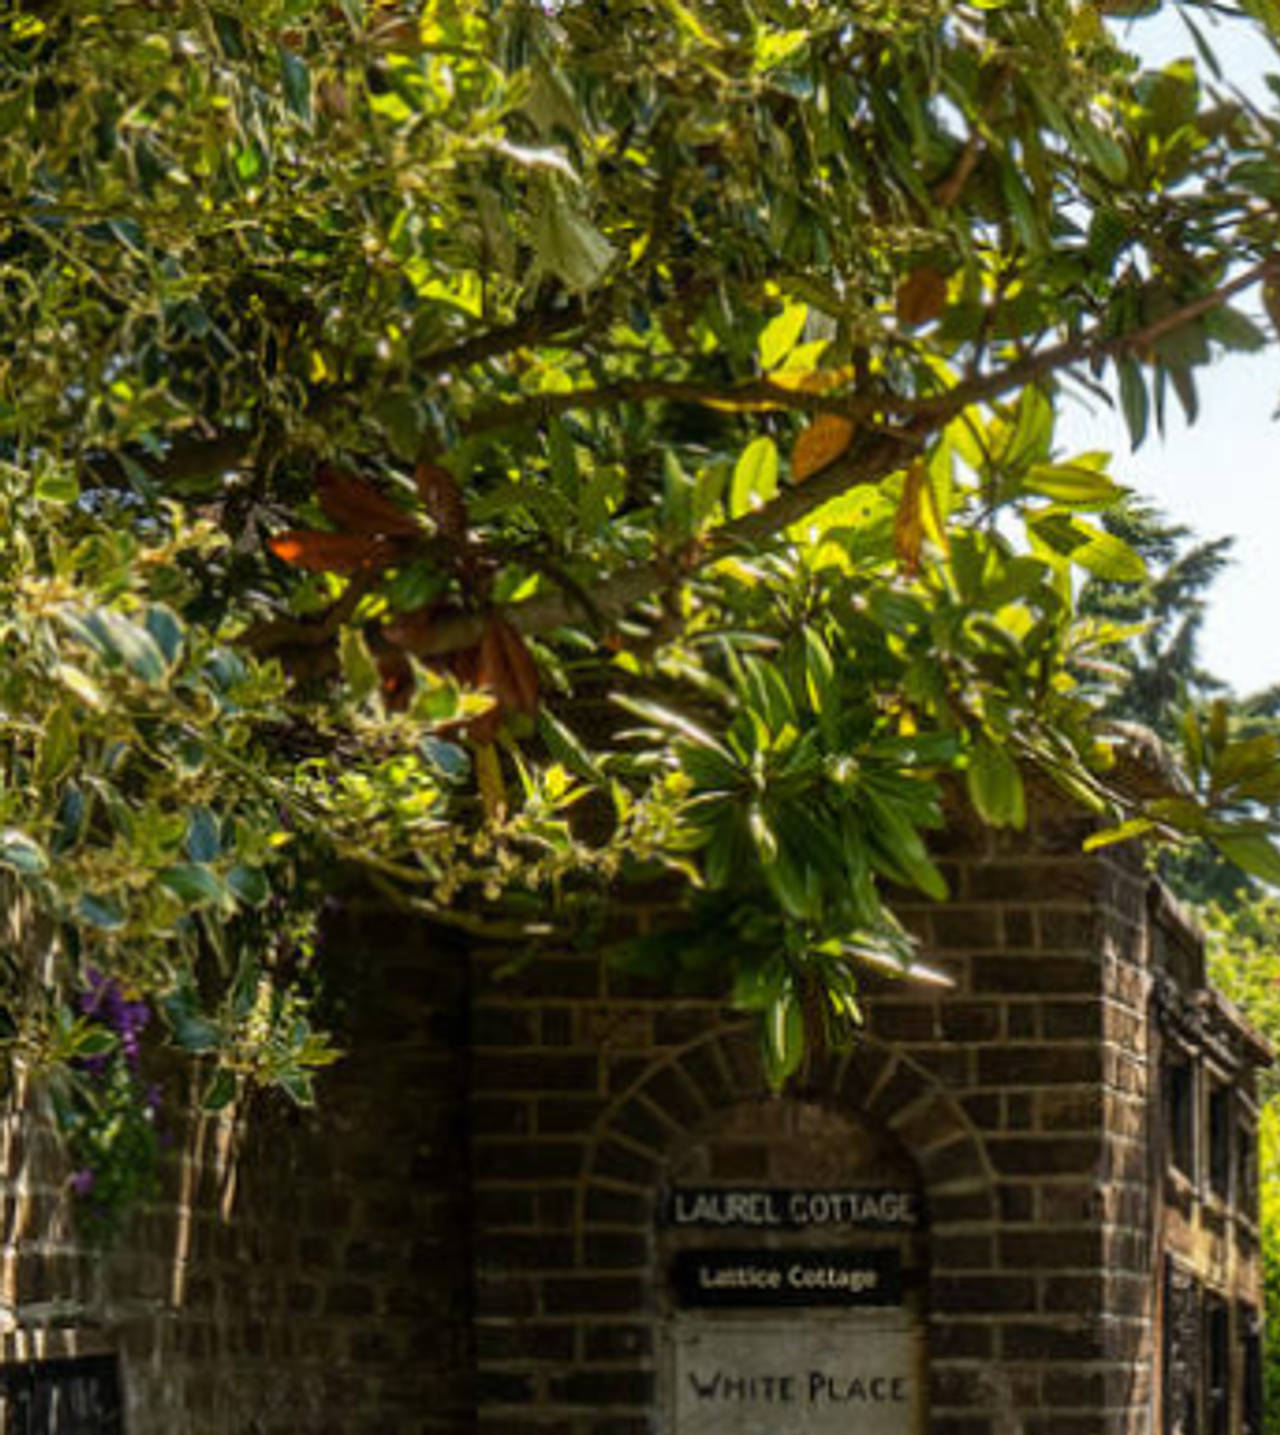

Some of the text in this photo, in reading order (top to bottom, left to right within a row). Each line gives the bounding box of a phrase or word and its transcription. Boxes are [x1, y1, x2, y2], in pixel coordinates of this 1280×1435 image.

[675, 1191, 917, 1222] LAUREL COTTAGE
[700, 1264, 877, 1292] Lattice Cottage
[689, 1370, 907, 1403] WHITE PLACE
